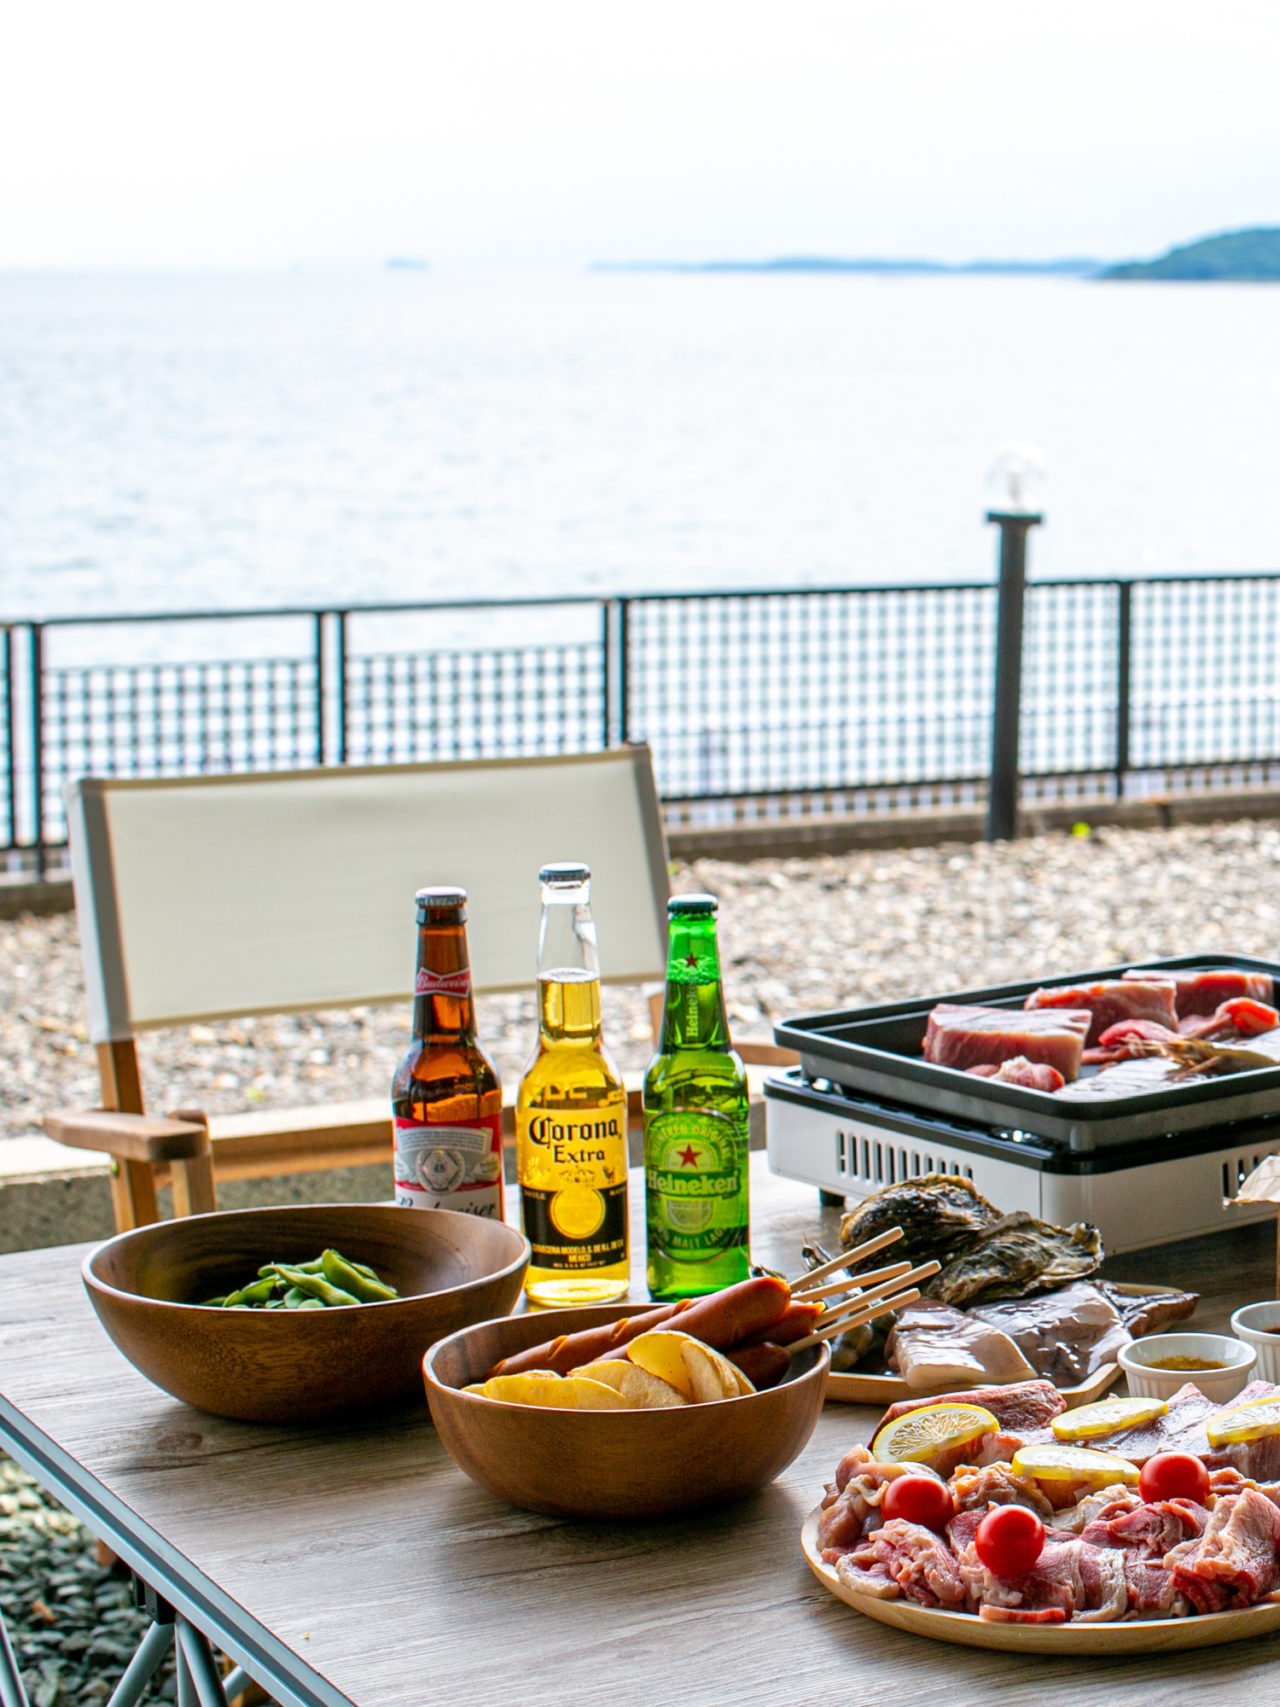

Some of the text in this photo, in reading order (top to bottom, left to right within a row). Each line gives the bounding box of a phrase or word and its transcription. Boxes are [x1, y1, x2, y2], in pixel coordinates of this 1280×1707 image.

[686, 979, 698, 1037] Heinek
[529, 1116, 618, 1149] Corona
[554, 1145, 605, 1163] Extra
[648, 1170, 737, 1195] Heineken
